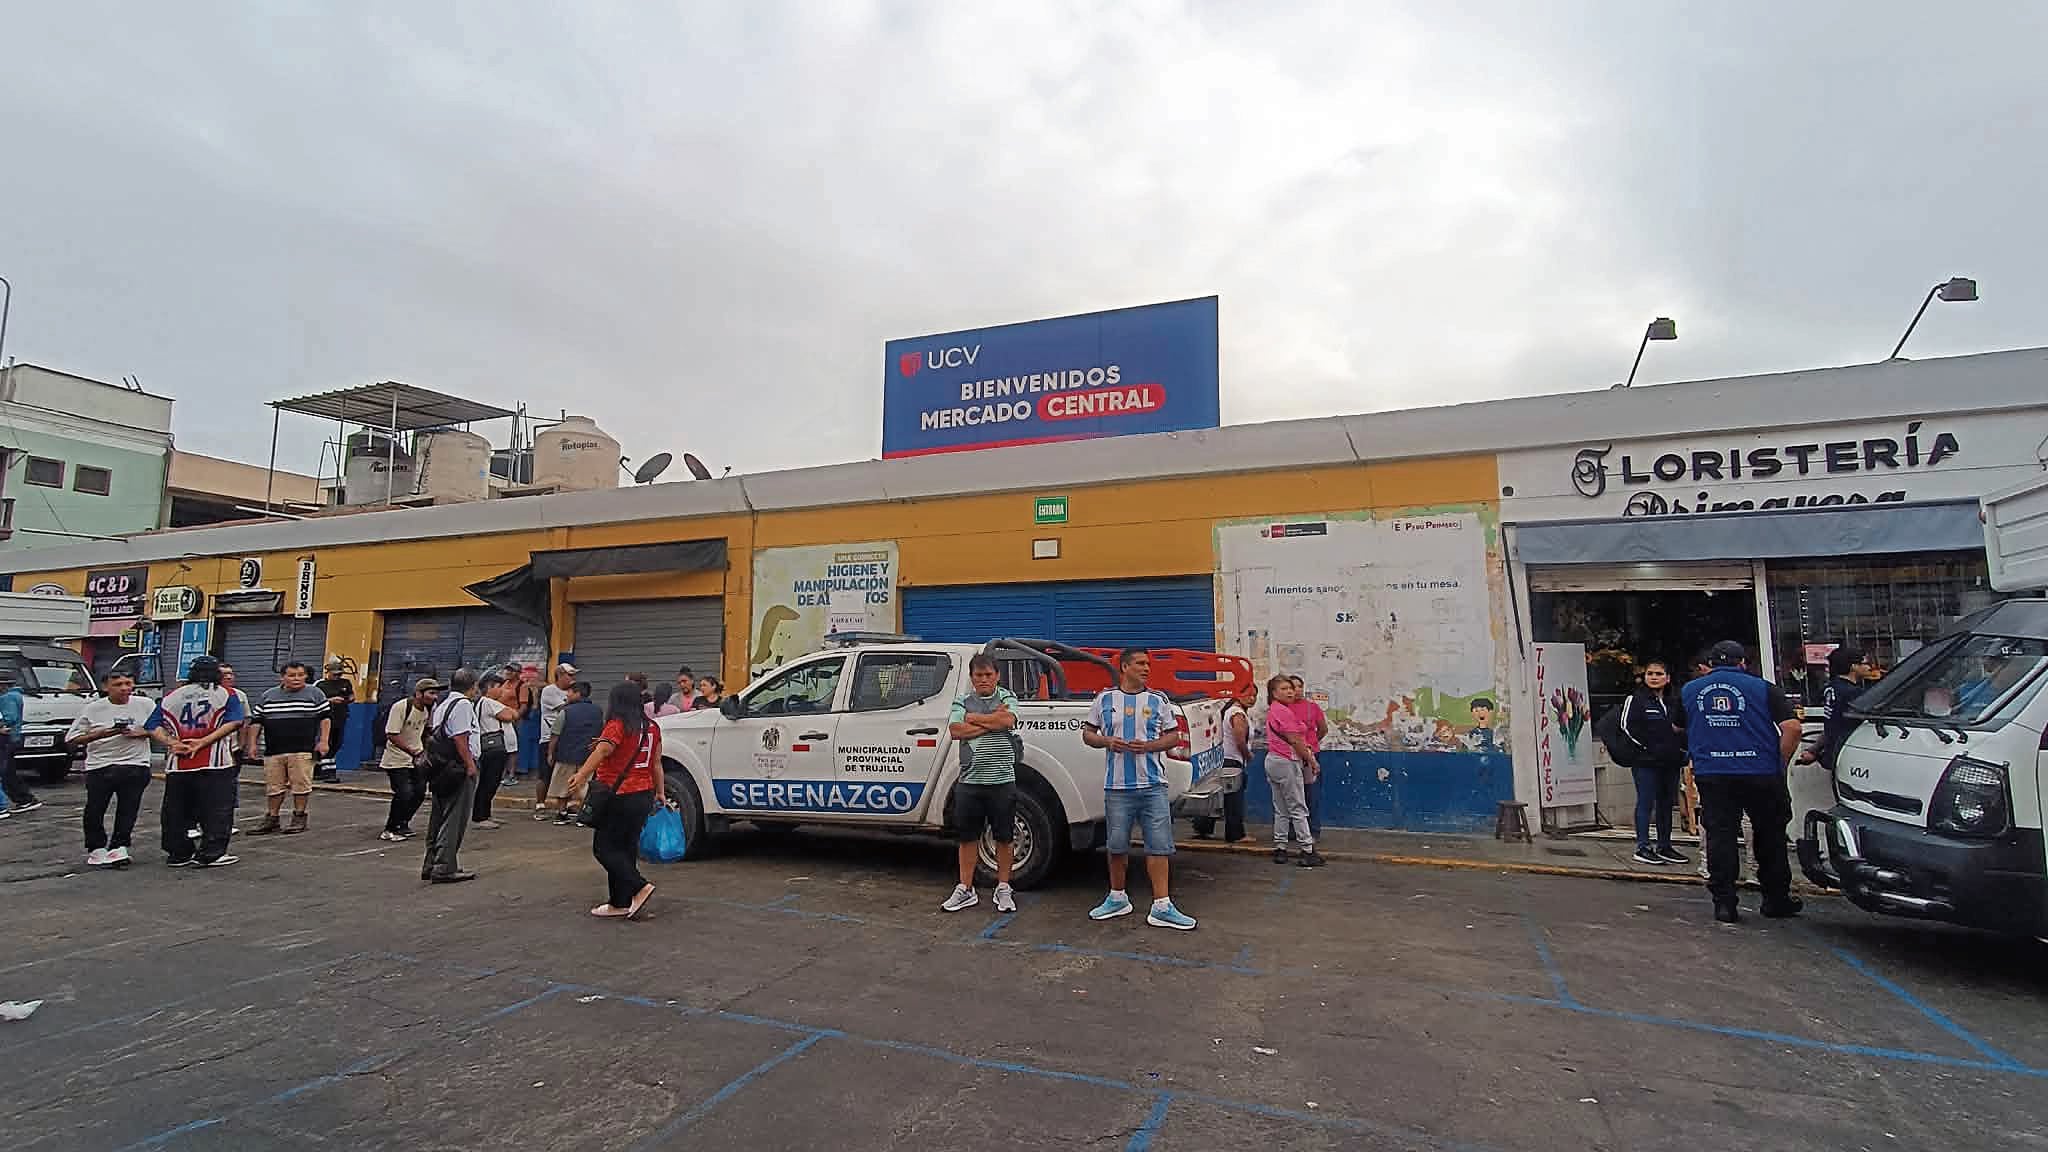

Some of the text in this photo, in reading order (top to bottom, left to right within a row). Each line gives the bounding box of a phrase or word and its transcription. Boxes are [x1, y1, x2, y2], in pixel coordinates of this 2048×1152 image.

[927, 345, 980, 370] UCV
[960, 365, 1121, 401] BIENVENIDOS
[920, 387, 1155, 431] MERCADO CENTRAL
[1571, 421, 1960, 497] FLORISTERÍA
[1038, 503, 1065, 516] ENTRADA
[827, 561, 889, 577] HIGIENE Y
[793, 576, 889, 592] MANIPULACIÓN
[1265, 584, 1313, 594] Alimentos
[1417, 580, 1428, 588] tu
[797, 591, 889, 606] DE ALTOS
[180, 700, 213, 730] 42
[1027, 721, 1046, 730] 742
[1048, 721, 1066, 730] 815
[1535, 647, 1553, 801] TULIPANES
[838, 746, 911, 754] MUNICIPALIDAD
[846, 755, 903, 764] PROVINCIAL
[859, 765, 905, 773] TRUJILLO
[1850, 767, 1869, 778] KIA
[731, 783, 912, 810] SERENAZGO
